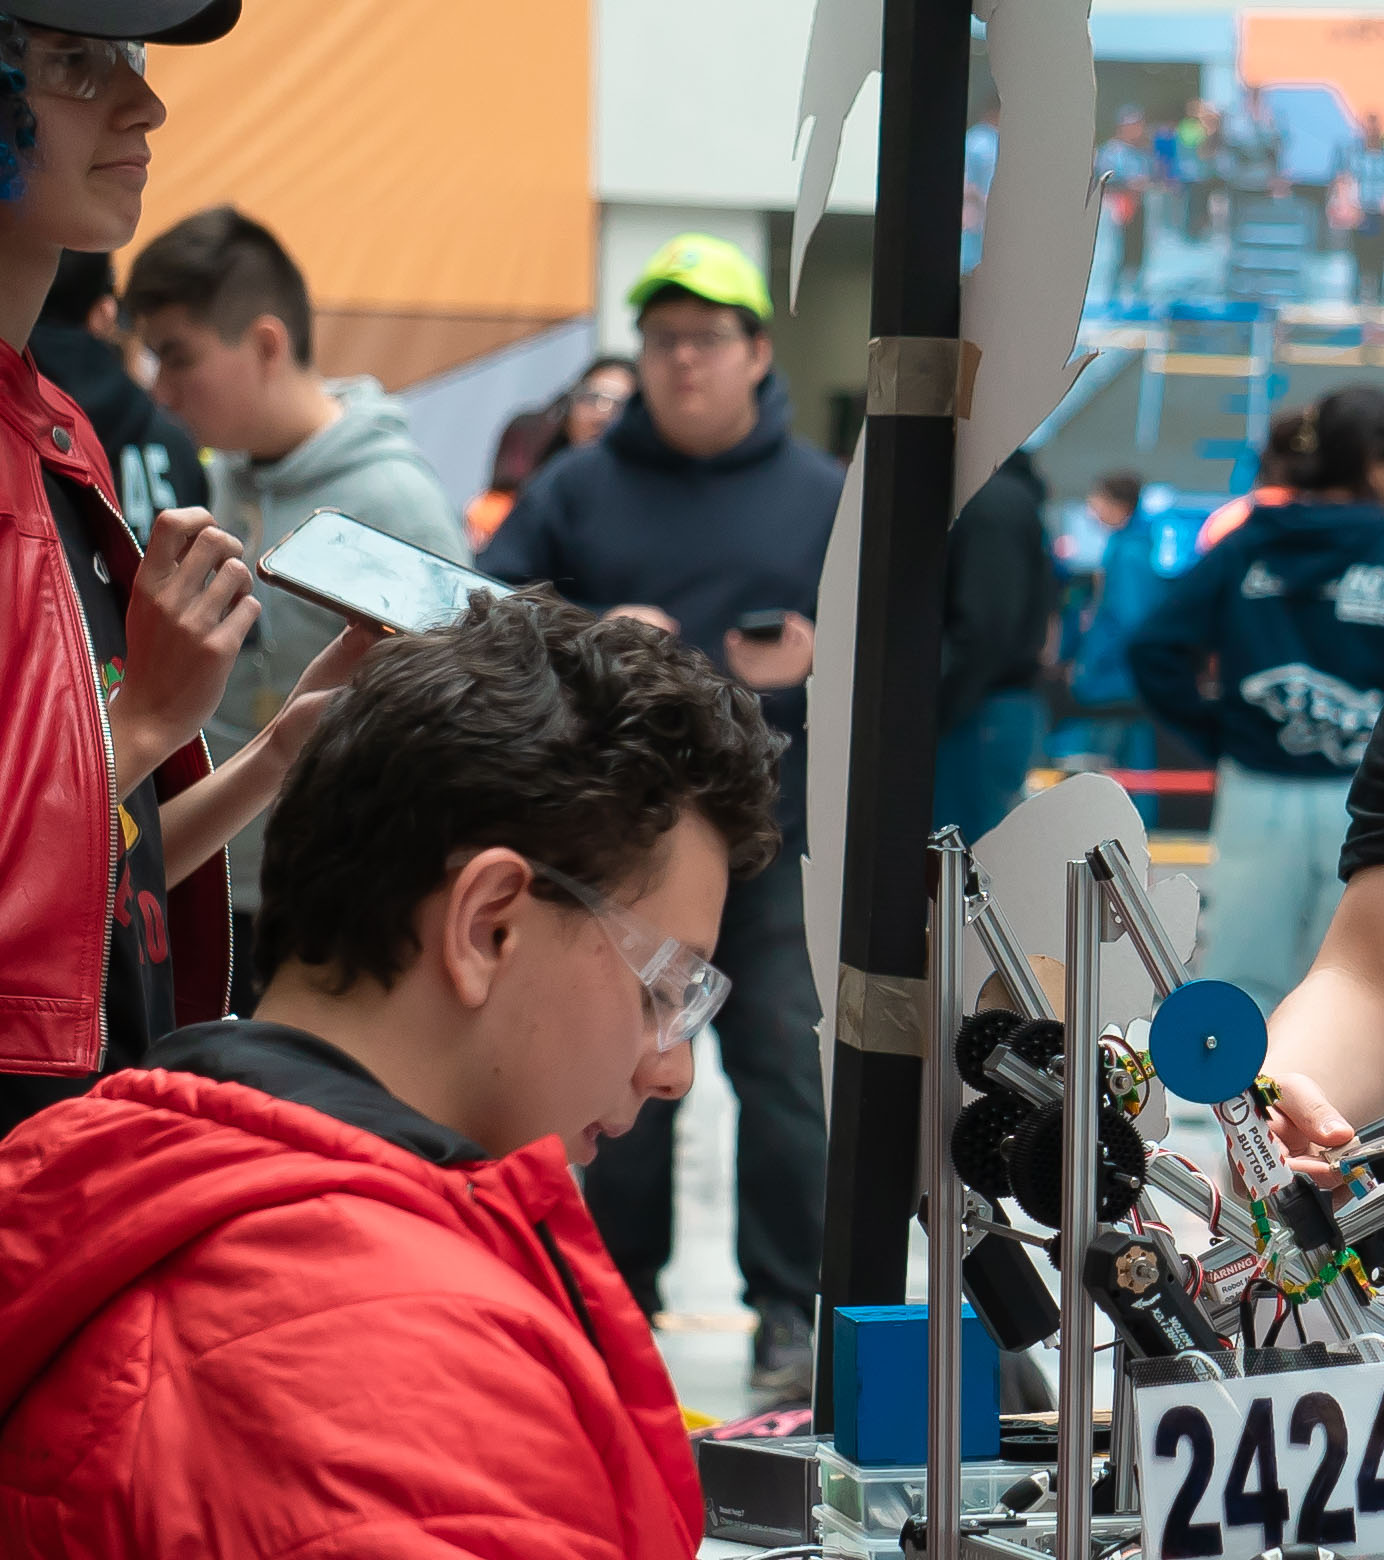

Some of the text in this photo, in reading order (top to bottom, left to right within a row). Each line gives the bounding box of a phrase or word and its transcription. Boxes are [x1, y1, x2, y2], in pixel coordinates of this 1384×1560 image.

[1236, 1133, 1269, 1184] BUTTON
[1248, 1126, 1277, 1171] POWER
[1221, 1281, 1244, 1294] Robot
